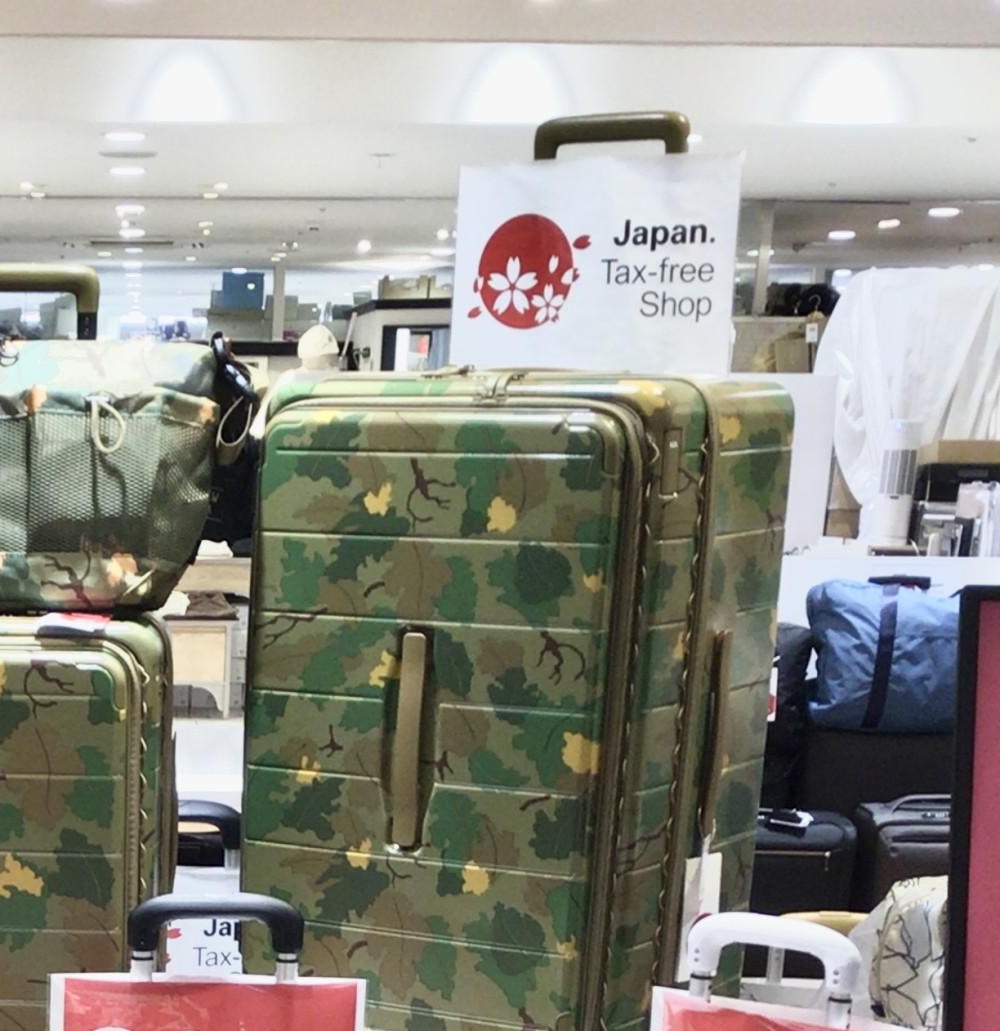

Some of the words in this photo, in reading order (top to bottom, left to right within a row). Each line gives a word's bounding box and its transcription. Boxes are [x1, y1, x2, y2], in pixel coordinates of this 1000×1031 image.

[613, 219, 716, 251] Japan.
[602, 257, 715, 285] Tax-free
[640, 291, 713, 322] Shop
[193, 946, 240, 967] Tax-
